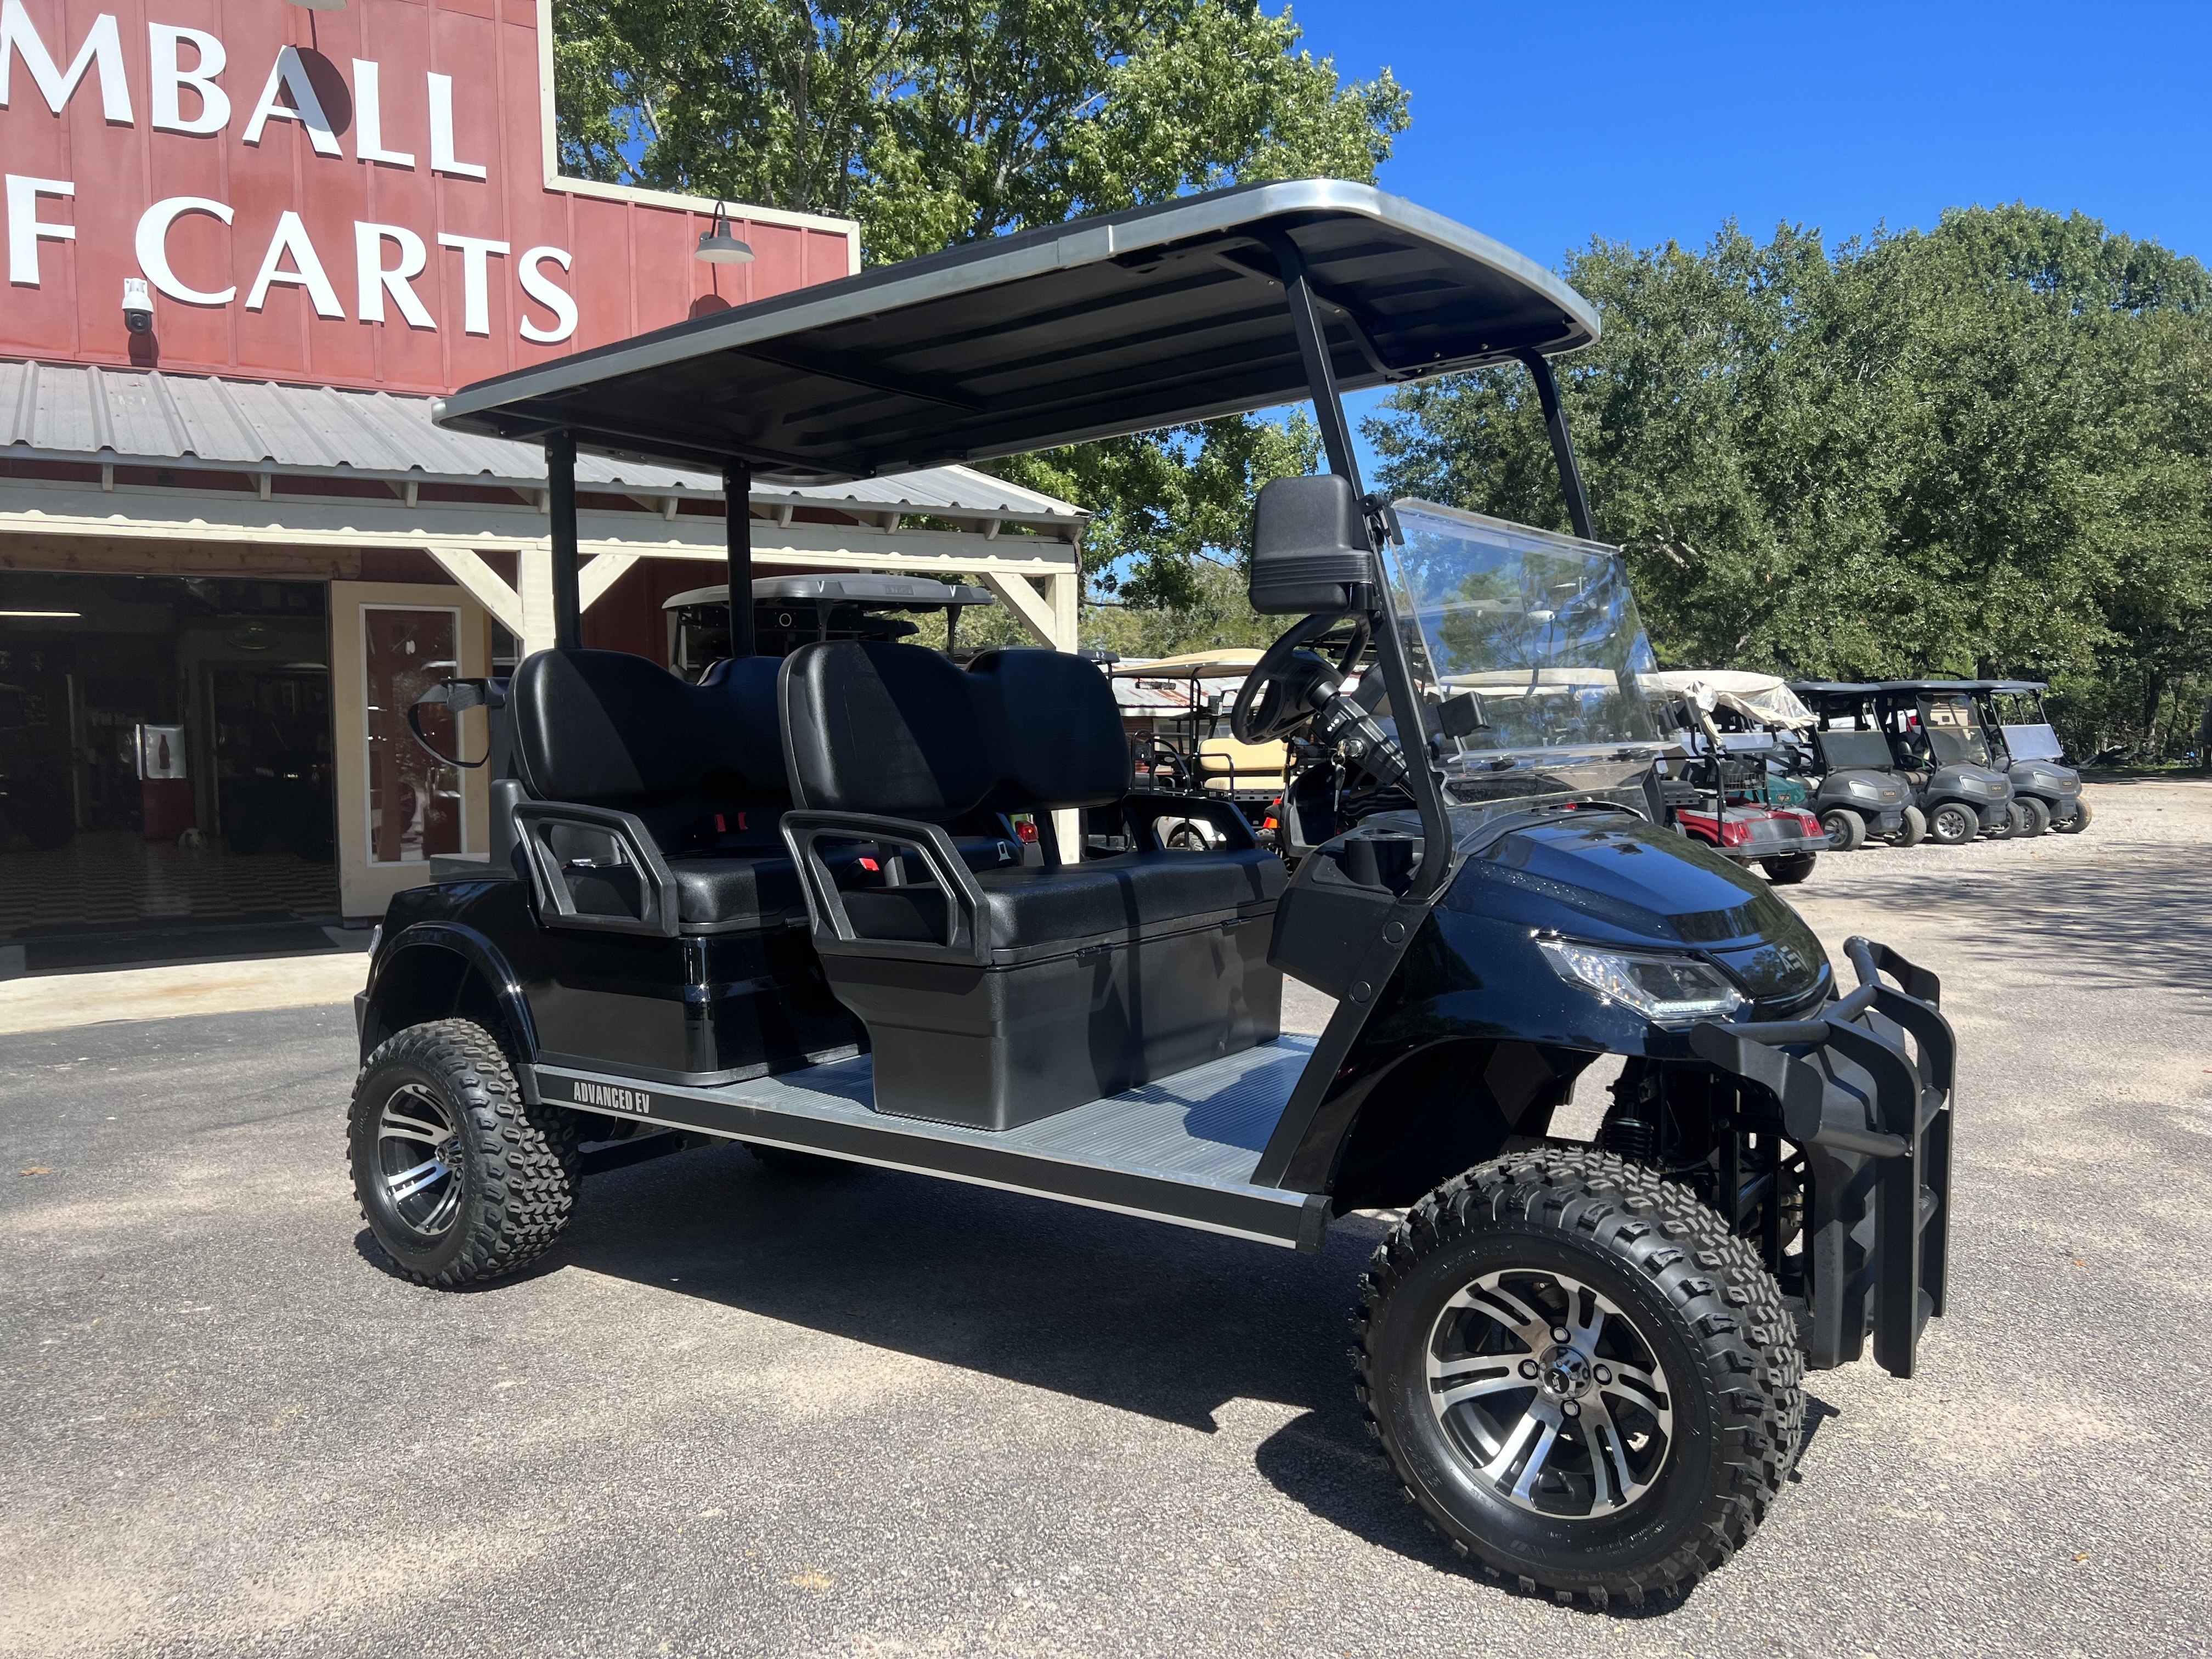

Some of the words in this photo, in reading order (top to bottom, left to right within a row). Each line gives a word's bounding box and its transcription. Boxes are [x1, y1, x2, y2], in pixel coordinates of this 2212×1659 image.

[0, 0, 487, 180] MBALL
[5, 174, 76, 284] F
[136, 196, 579, 343] CARTS
[574, 1081, 633, 1110] ADVANCED
[635, 1092, 650, 1114] EV
